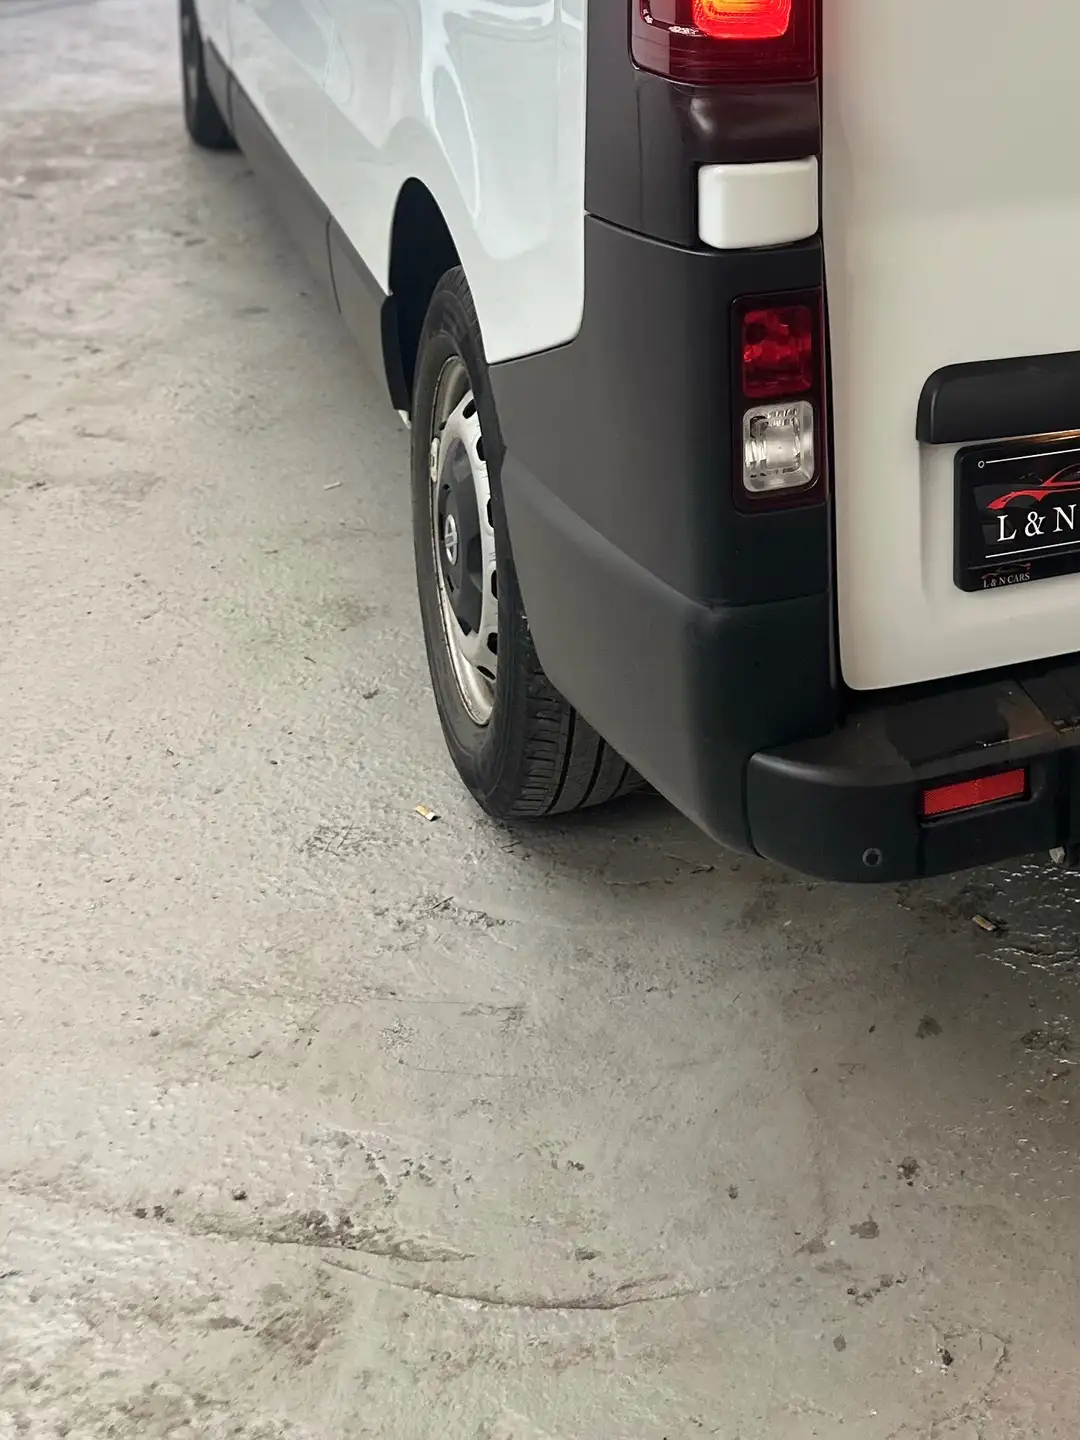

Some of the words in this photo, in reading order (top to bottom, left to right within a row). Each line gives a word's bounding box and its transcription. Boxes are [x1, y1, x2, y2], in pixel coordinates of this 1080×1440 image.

[996, 514, 1018, 543] L
[1024, 511, 1047, 538] &
[1052, 503, 1078, 534] N
[1007, 572, 1031, 584] CARS
